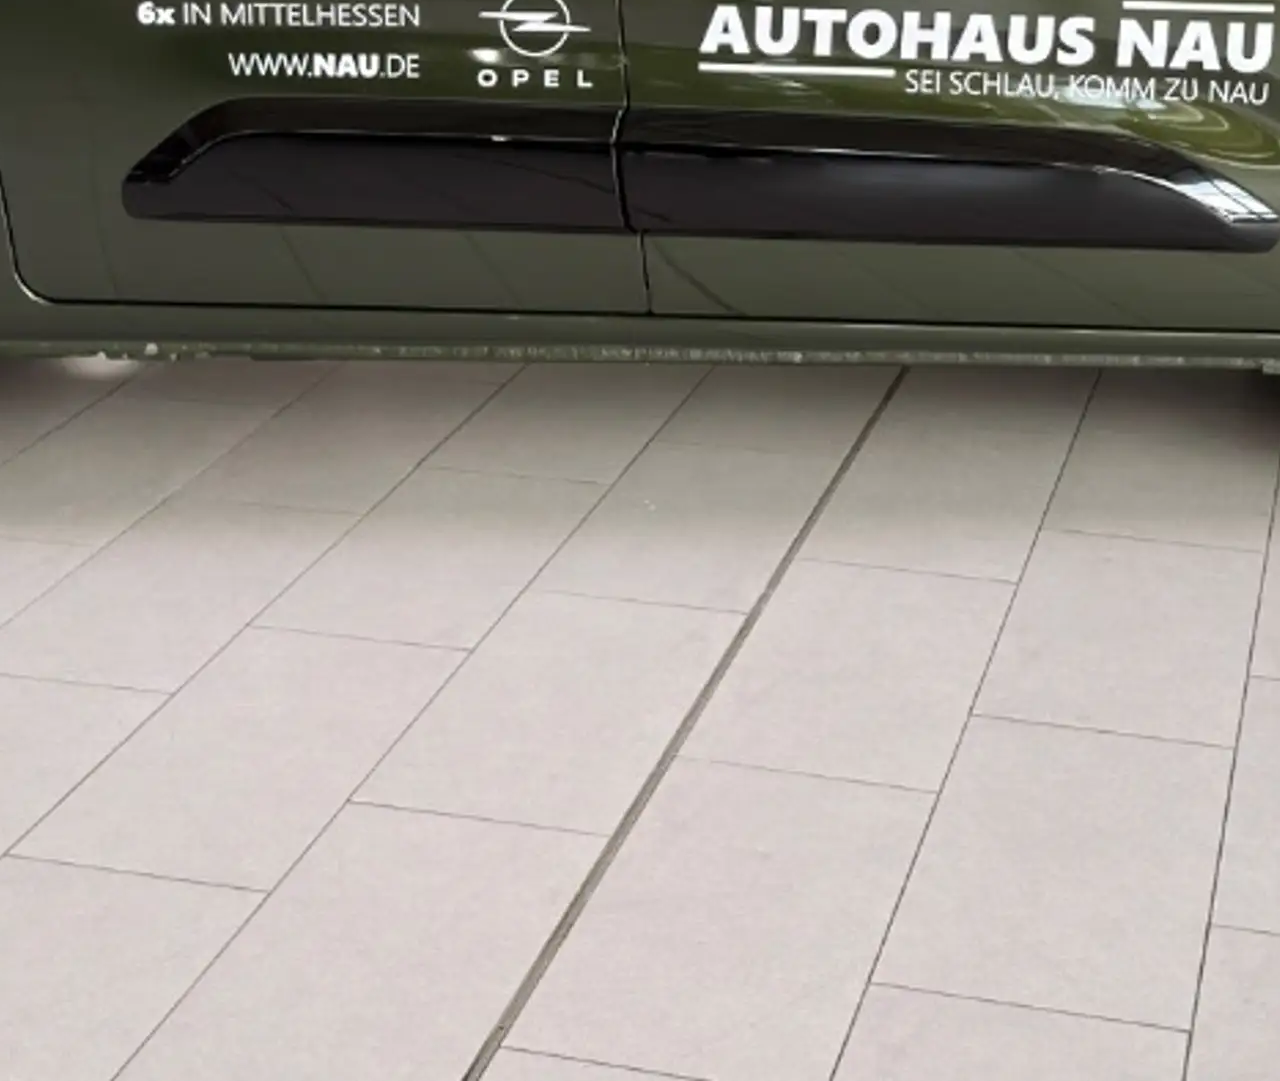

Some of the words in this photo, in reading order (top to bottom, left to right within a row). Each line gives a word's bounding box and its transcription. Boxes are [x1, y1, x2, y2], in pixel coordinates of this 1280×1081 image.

[136, 0, 175, 25] 6x
[182, 2, 211, 25] IN
[220, 2, 420, 27] MITTELHESSEN
[699, 3, 1095, 67] AUTOHAUS
[1116, 18, 1274, 73] NAU
[228, 52, 420, 78] WWW.NAU.DE
[477, 68, 594, 88] OPEL
[905, 69, 941, 94] SEI
[949, 71, 1059, 100] SCHLAU,
[1070, 74, 1155, 102] KOMM
[1163, 77, 1198, 101] ZU
[1208, 79, 1270, 105] NAU
